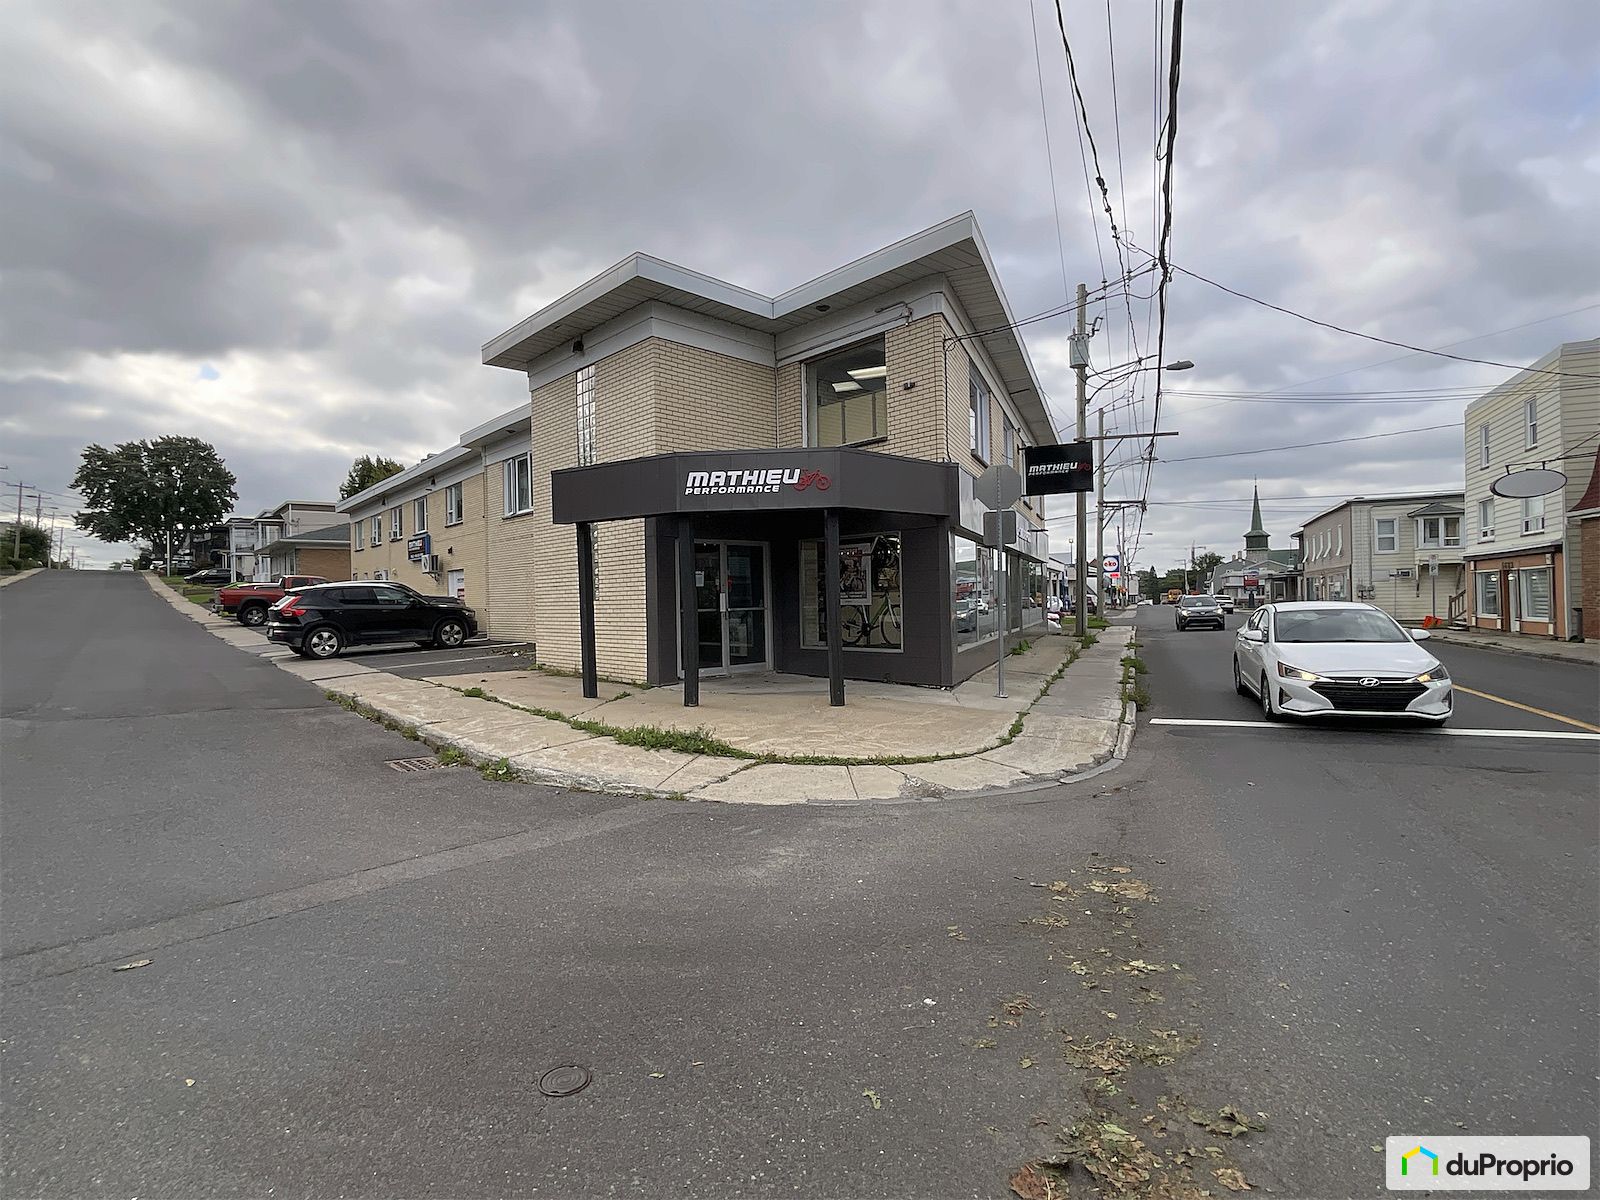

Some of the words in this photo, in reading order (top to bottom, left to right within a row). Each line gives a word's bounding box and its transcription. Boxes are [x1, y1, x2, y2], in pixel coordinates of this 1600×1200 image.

[1029, 462, 1078, 473] MATHIEU
[686, 468, 800, 487] MATHIEU
[685, 485, 780, 495] PERFORMANCE
